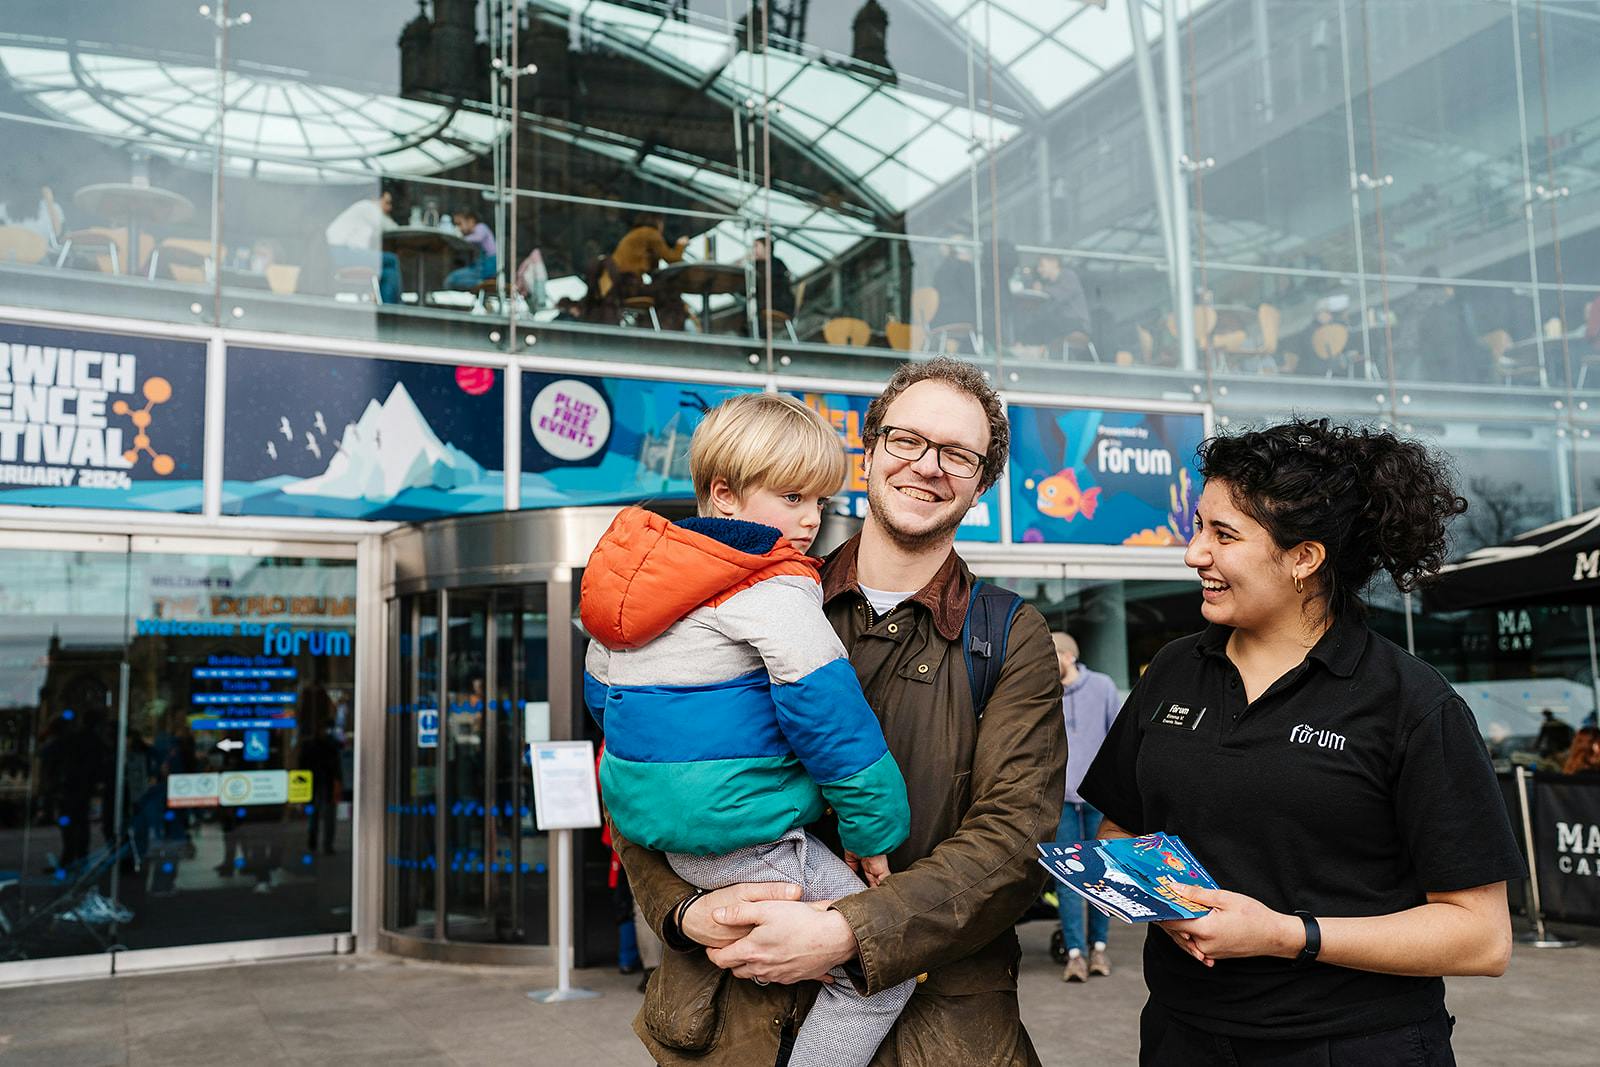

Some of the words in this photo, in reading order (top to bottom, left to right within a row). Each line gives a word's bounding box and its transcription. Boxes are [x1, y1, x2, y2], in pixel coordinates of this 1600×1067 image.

[556, 393, 598, 418] PLUS!
[539, 416, 594, 447] EVENTS
[554, 407, 590, 431] FREE
[1097, 438, 1173, 476] forum
[79, 469, 132, 490] 2024
[136, 619, 235, 637] Welcome
[240, 621, 262, 637] to
[263, 622, 351, 657] forum
[1289, 724, 1347, 751] forum
[1558, 855, 1600, 877] CA
